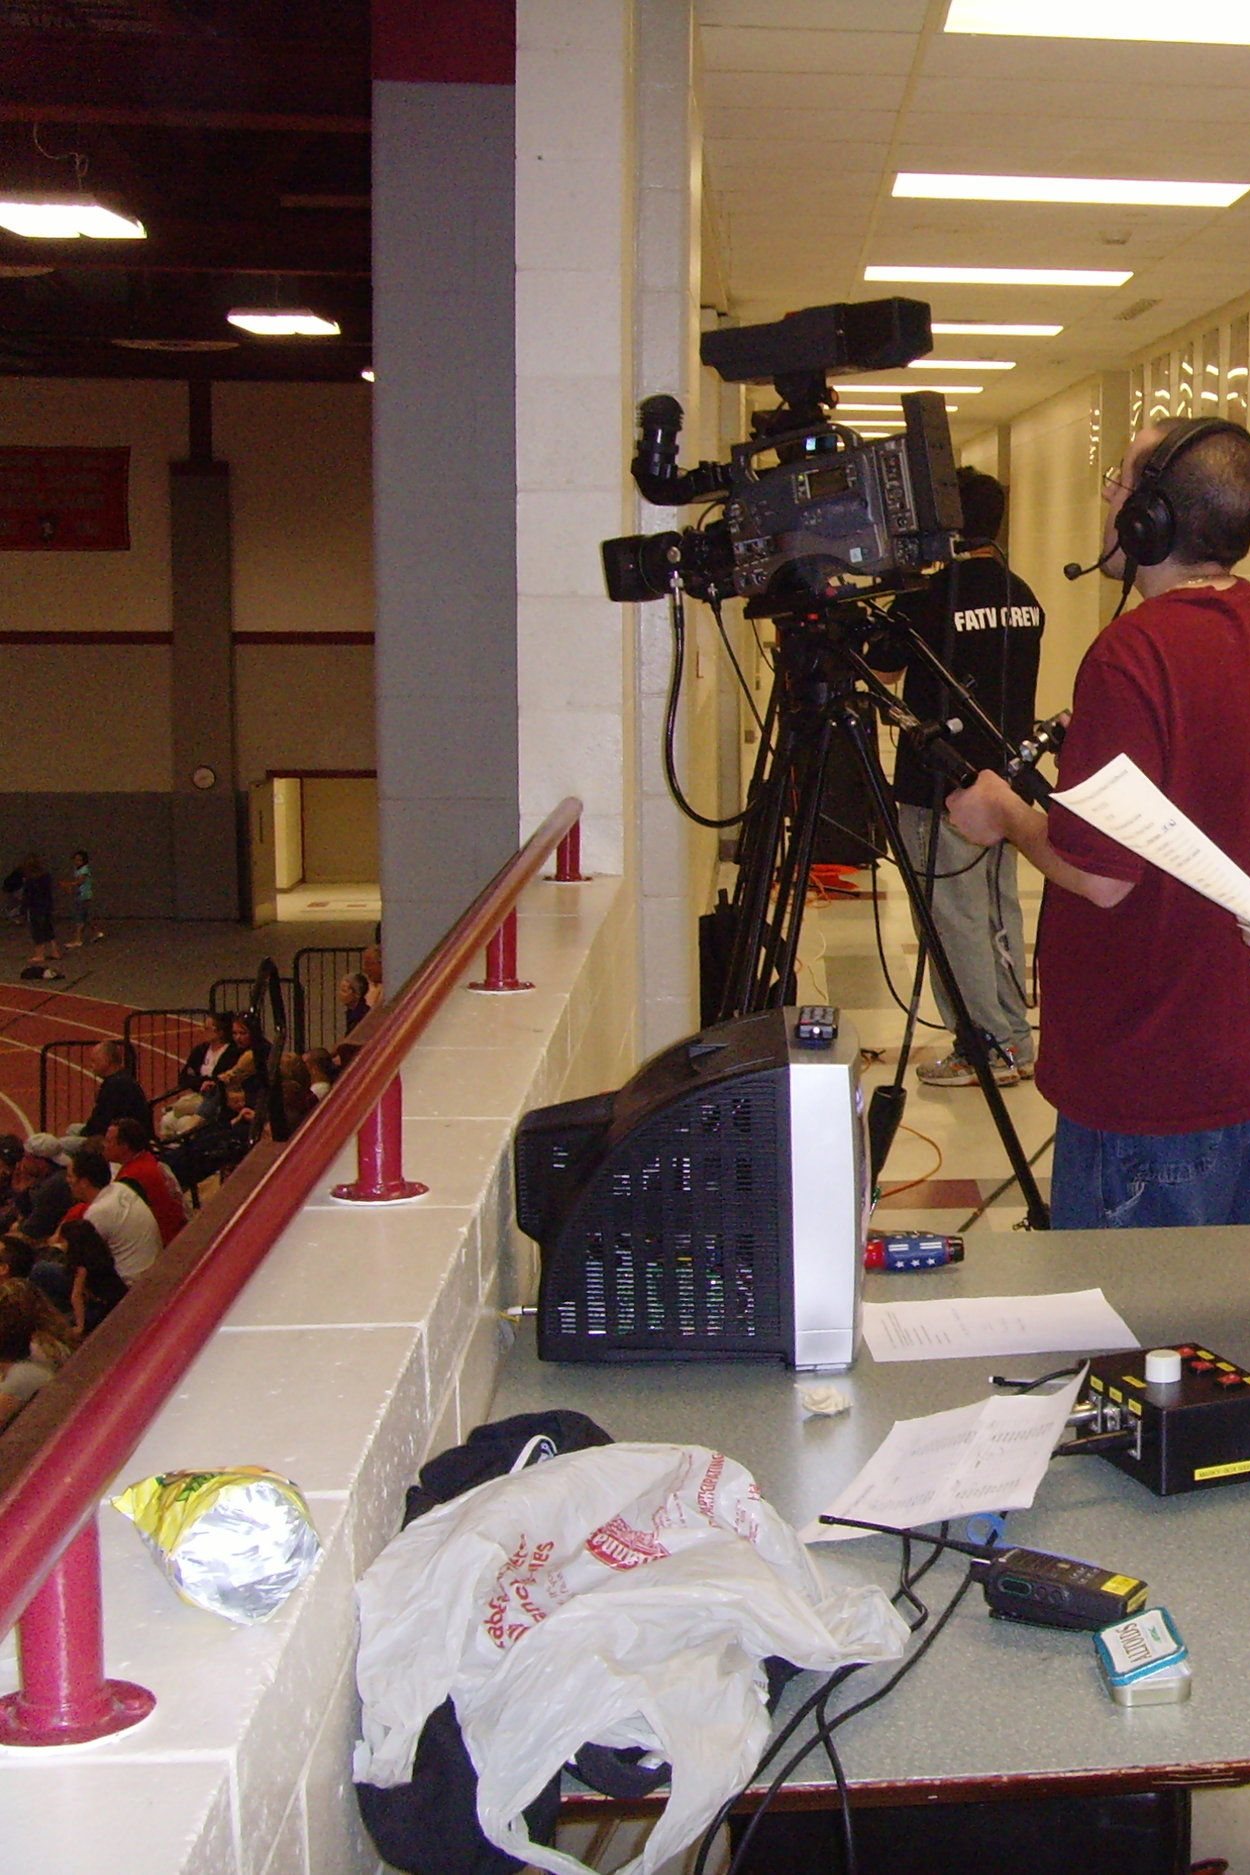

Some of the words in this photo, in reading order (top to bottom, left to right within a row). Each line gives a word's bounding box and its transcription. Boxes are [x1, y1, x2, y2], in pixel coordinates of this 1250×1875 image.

[954, 607, 997, 632] FATV
[1000, 606, 1040, 627] CREW
[1115, 1622, 1151, 1663] ALTOIDS
